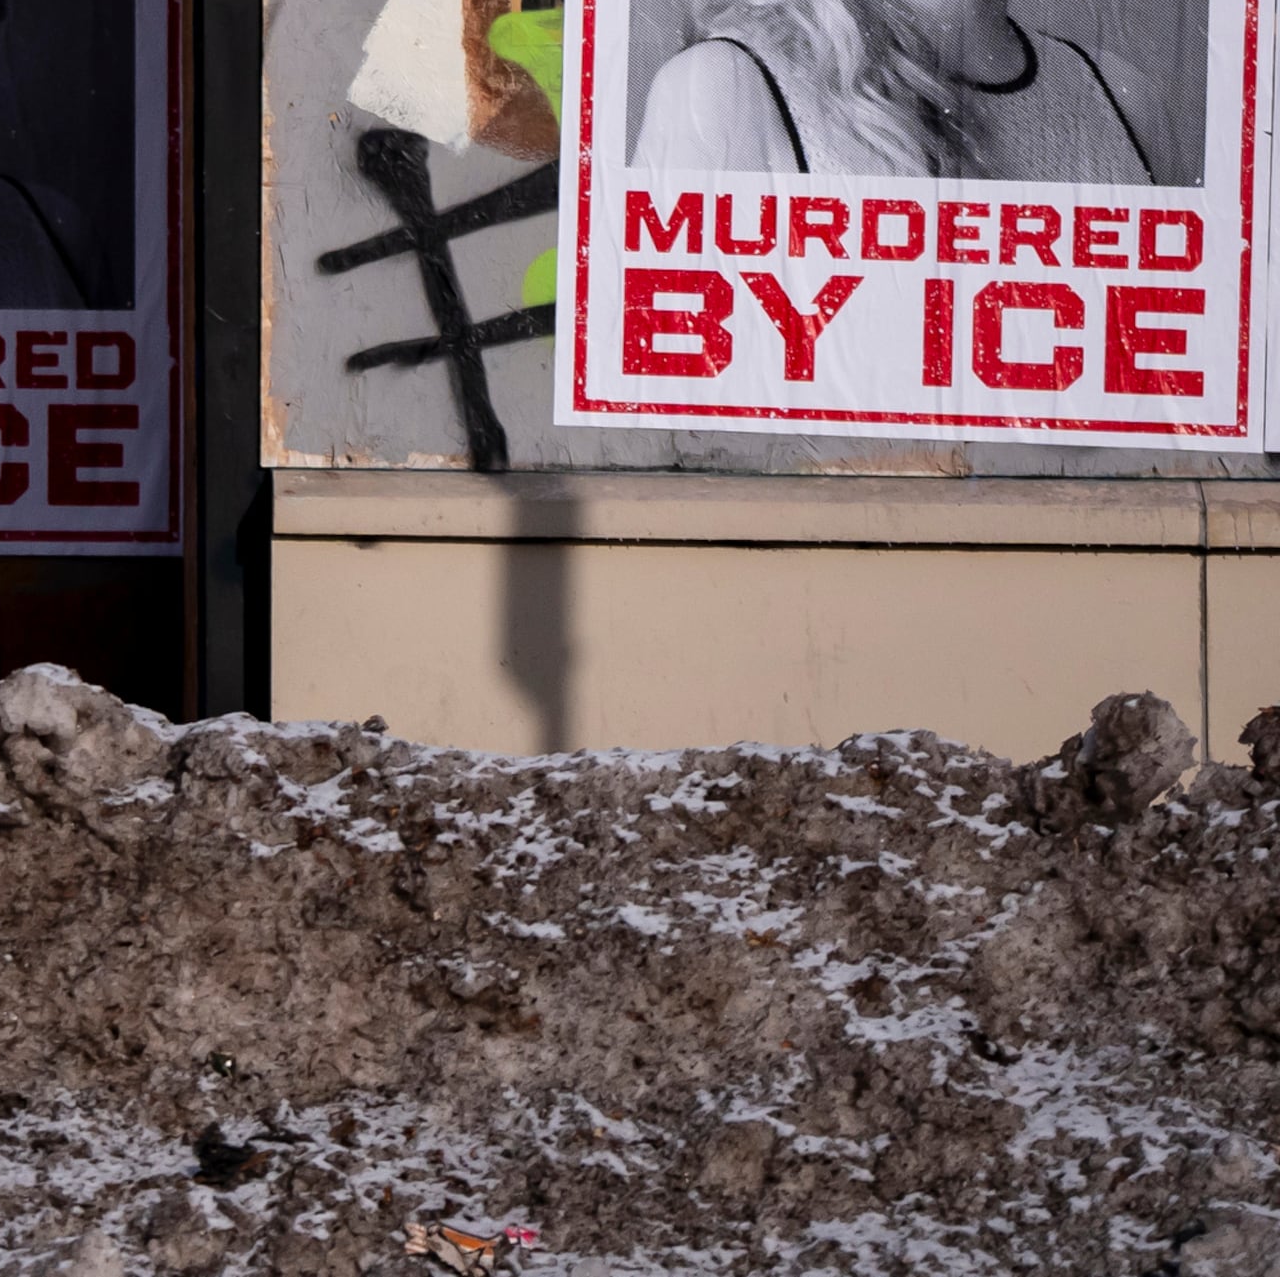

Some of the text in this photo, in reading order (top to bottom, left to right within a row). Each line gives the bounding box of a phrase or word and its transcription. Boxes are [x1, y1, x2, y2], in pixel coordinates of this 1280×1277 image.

[625, 191, 1203, 272] MURDERED
[623, 268, 1205, 397] BY ICE
